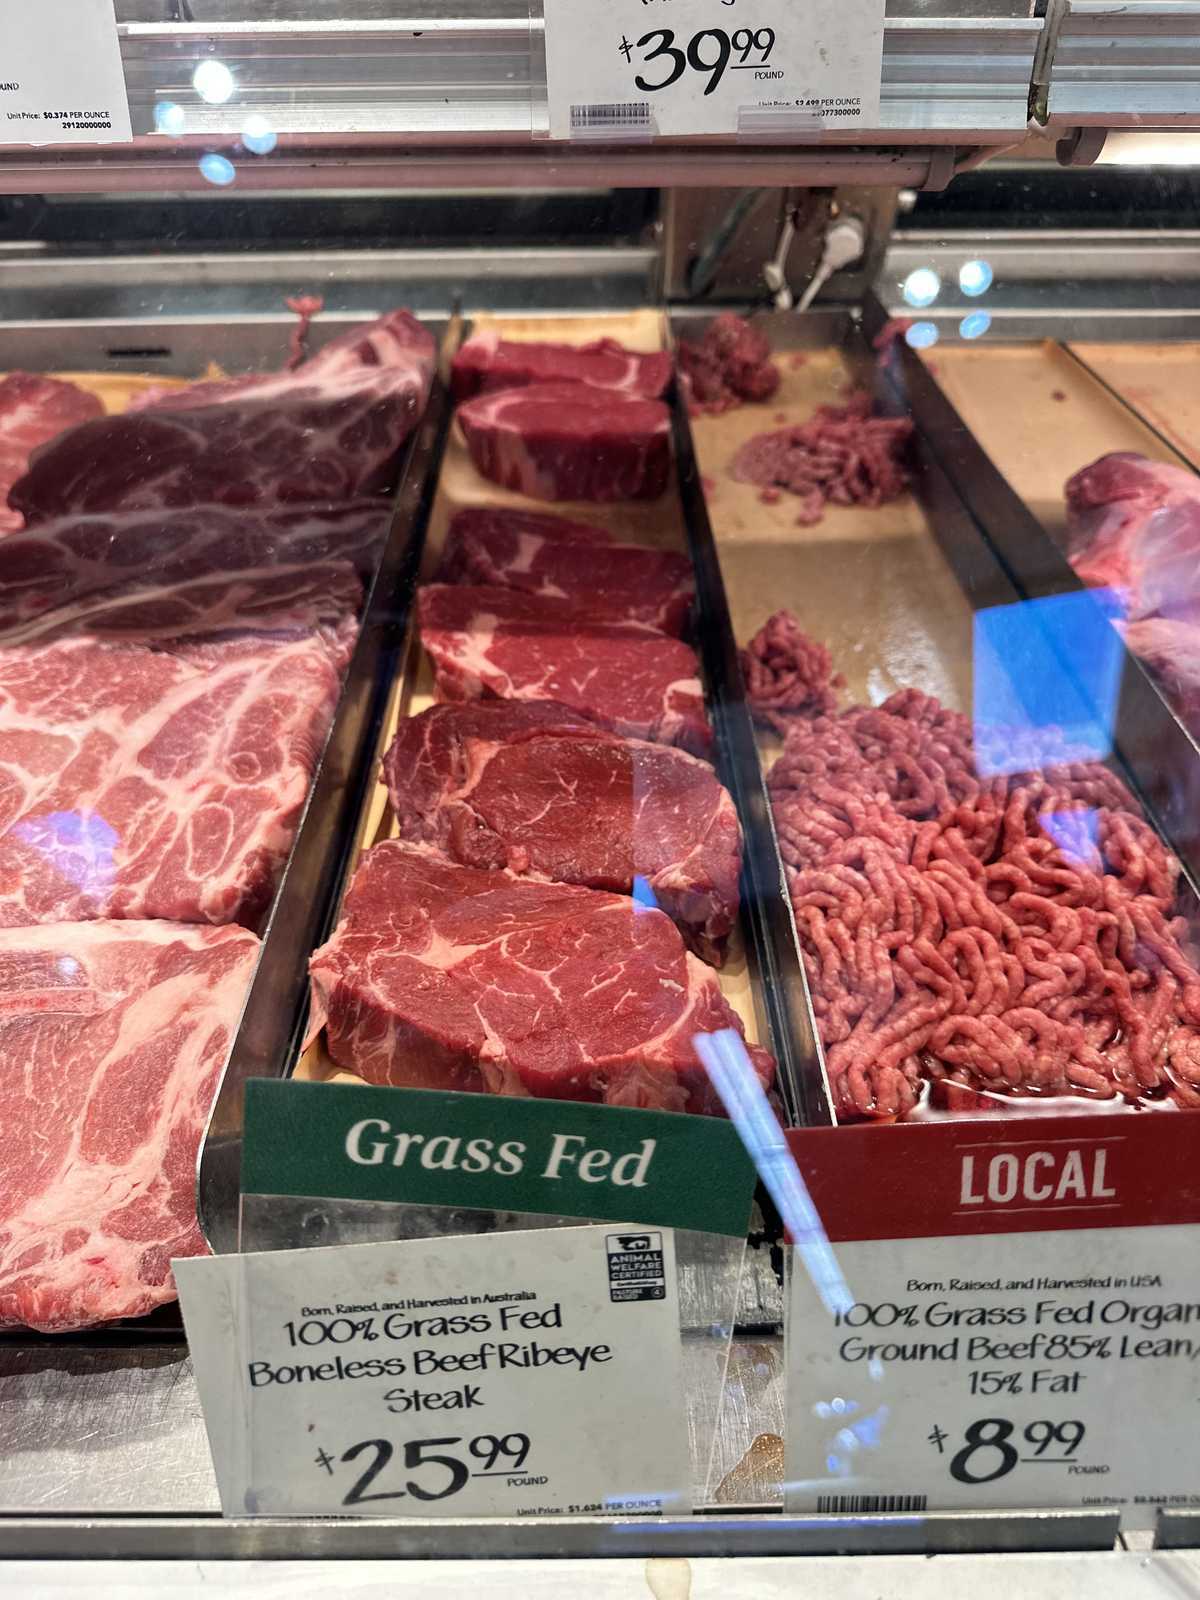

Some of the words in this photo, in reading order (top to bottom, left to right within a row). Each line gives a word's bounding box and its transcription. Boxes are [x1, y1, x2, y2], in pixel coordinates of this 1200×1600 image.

[754, 71, 784, 80] POUND
[836, 98, 861, 106] OUNCE
[344, 1118, 526, 1175] Grass
[540, 1133, 657, 1188] Fed
[960, 1149, 1116, 1205] LOCAL
[610, 1262, 661, 1271] WELFARE
[611, 1253, 661, 1264] ANIMAL
[611, 1270, 662, 1279] CERTIFIED
[906, 1278, 946, 1292] Born,
[1005, 1276, 1034, 1290] and
[1036, 1275, 1111, 1290] Harvested
[1114, 1275, 1128, 1289] in
[1130, 1274, 1163, 1288] USA
[336, 1302, 380, 1314] Raised,
[381, 1300, 405, 1310] and
[407, 1296, 469, 1309] Harvested
[470, 1294, 482, 1305] in
[483, 1291, 537, 1303] Australia
[834, 1303, 921, 1328] 100%
[925, 1301, 1027, 1328] Grass
[1034, 1299, 1096, 1325] Fed
[283, 1316, 380, 1347] 100%
[383, 1312, 492, 1341] Grass
[499, 1302, 564, 1333] Fed
[839, 1336, 959, 1362] Ground
[967, 1332, 1047, 1361] Beef
[1044, 1334, 1112, 1359] 85%
[248, 1357, 407, 1388] Boneless
[412, 1343, 497, 1377] Beef
[498, 1341, 614, 1371] Ribeye
[967, 1369, 1024, 1396] 15%
[1030, 1370, 1087, 1394] Fat
[382, 1384, 486, 1414] Steak
[1068, 1464, 1110, 1475] POUND
[506, 1474, 549, 1487] POUND
[605, 1502, 625, 1511] PER
[625, 1499, 662, 1508] OUNCE
